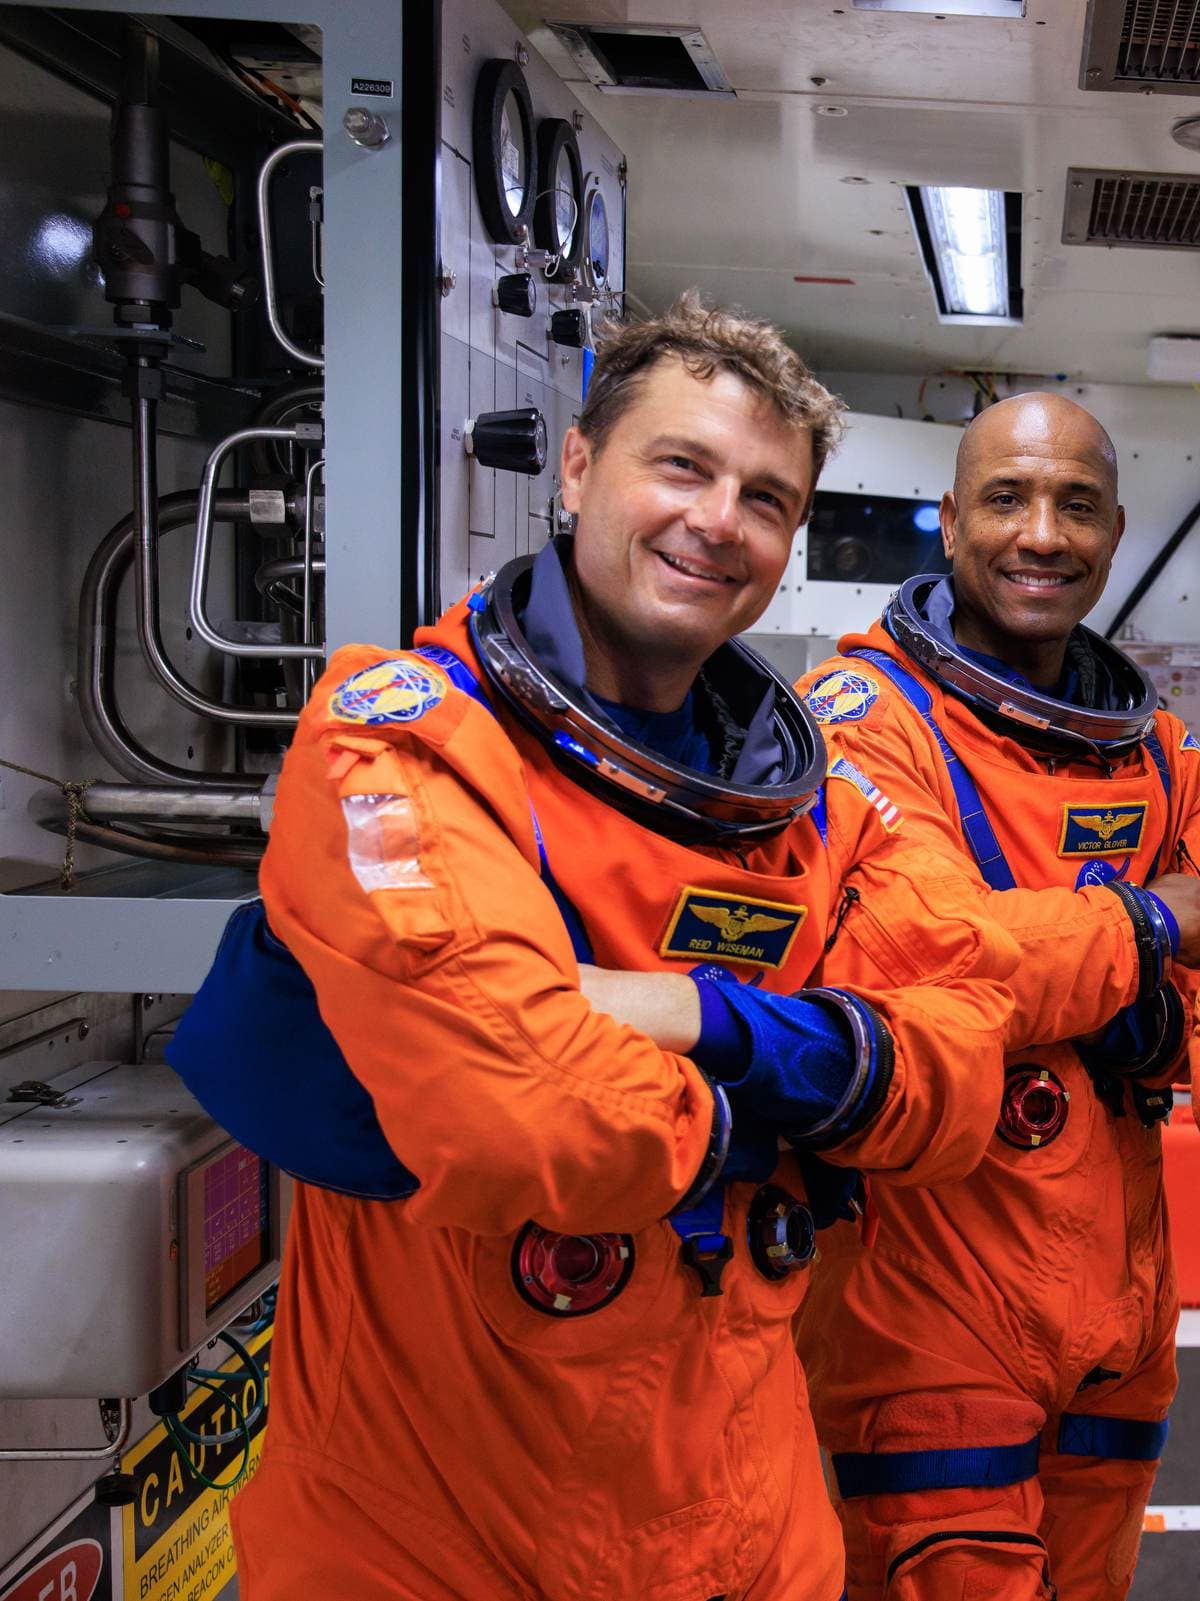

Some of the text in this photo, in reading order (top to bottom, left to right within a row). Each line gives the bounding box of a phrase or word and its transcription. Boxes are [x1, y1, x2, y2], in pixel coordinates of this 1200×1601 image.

[1077, 839, 1127, 850] VICTOR GLOVER
[688, 938, 764, 958] REID WISEMAN
[141, 1508, 210, 1600] BREATHING
[212, 1488, 230, 1520] AIR
[182, 1522, 229, 1590] ANALYZER
